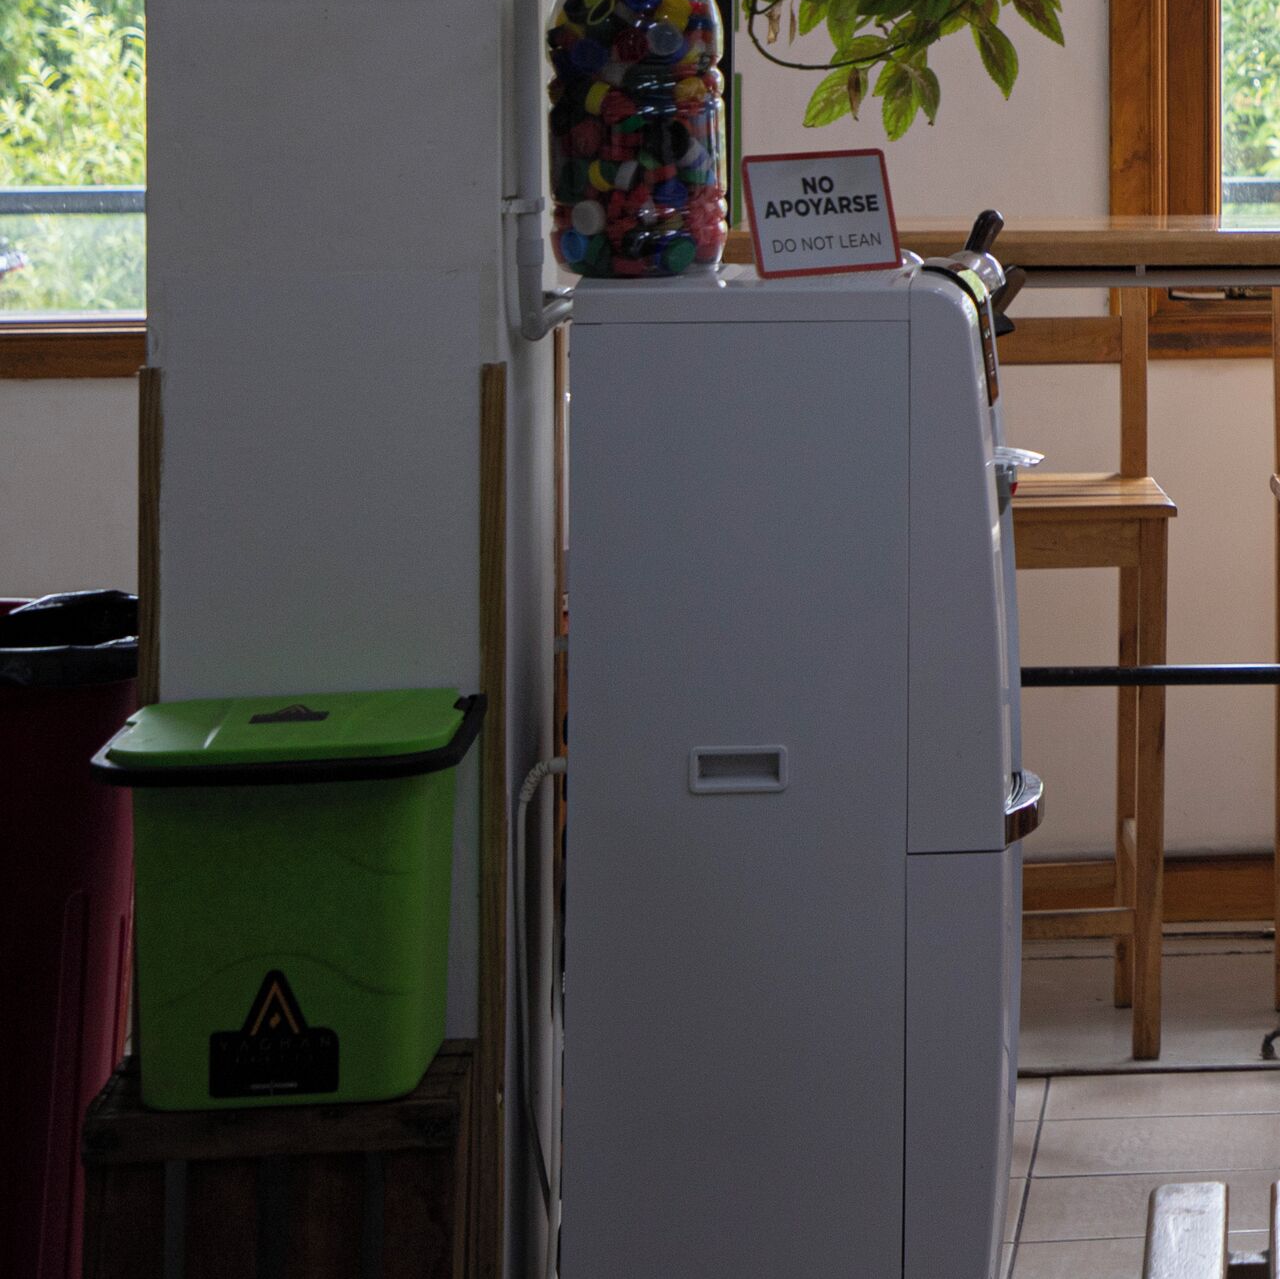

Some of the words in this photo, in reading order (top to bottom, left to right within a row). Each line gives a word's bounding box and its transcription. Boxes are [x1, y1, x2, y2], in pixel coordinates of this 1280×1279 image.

[802, 176, 834, 194] NO
[765, 194, 880, 219] APOYARSE
[772, 239, 796, 254] DO
[801, 235, 834, 251] NOT
[839, 232, 881, 248] LEAN
